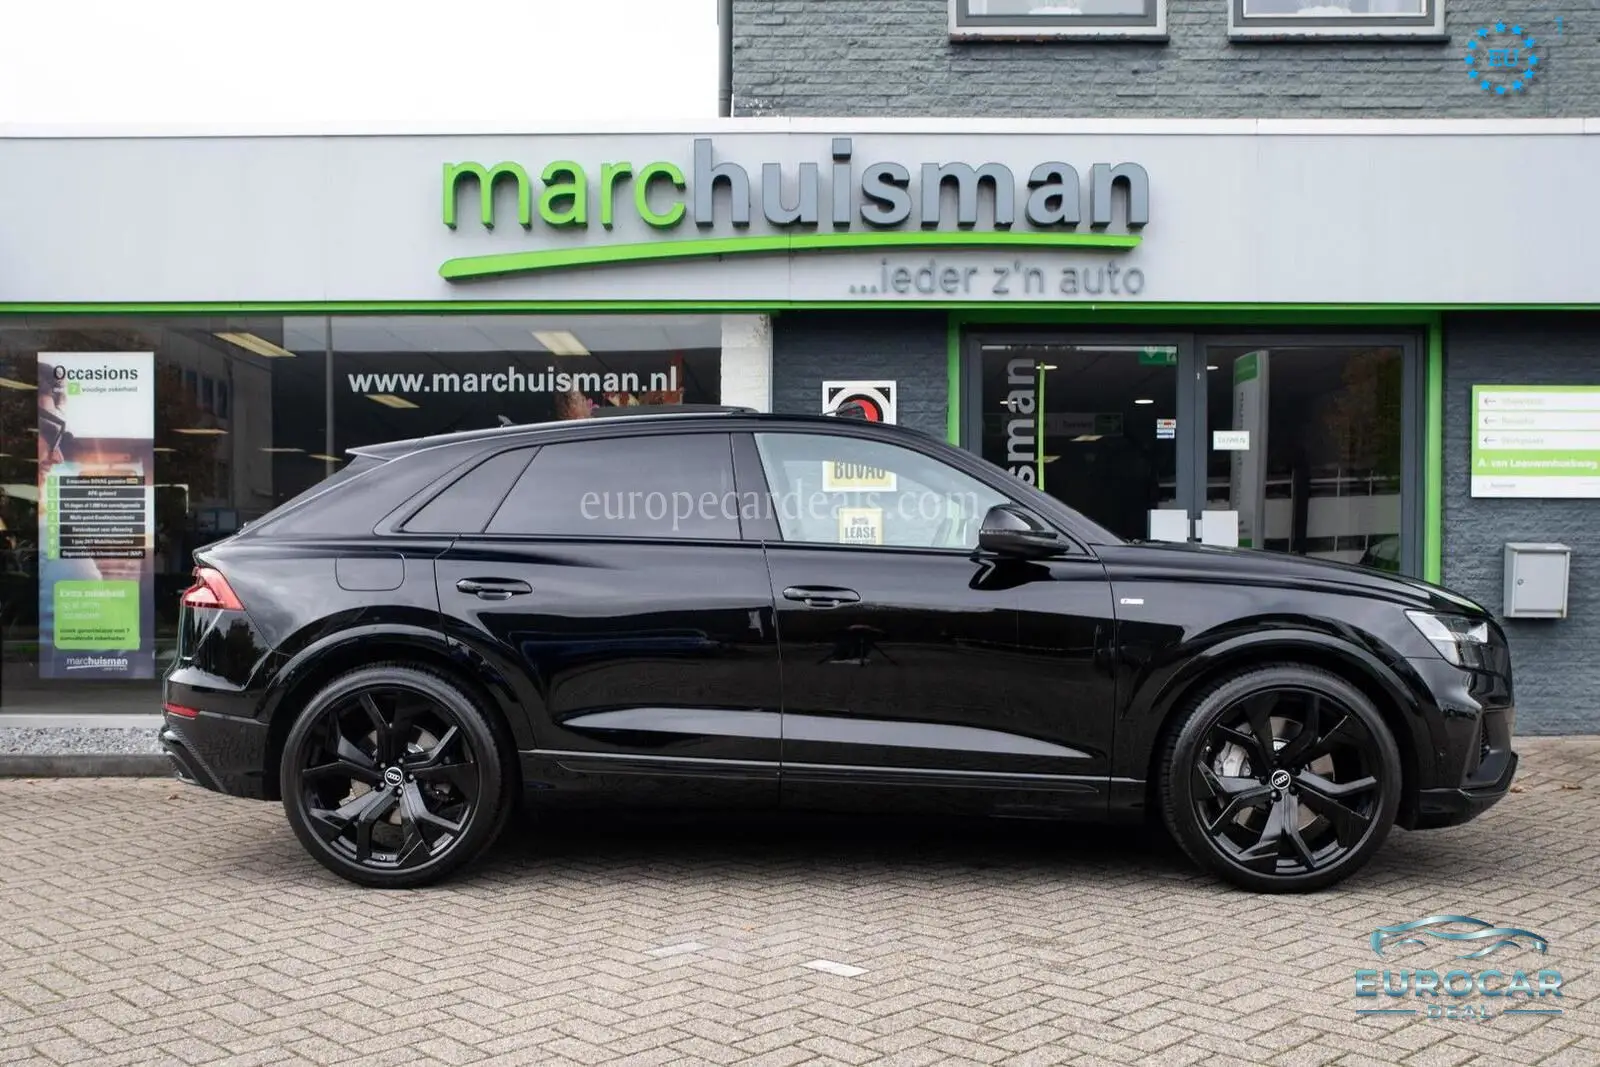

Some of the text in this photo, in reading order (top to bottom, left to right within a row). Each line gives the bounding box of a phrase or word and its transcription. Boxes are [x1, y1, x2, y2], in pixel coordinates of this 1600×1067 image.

[442, 138, 1150, 231] marchuisman
[992, 261, 1045, 295] z'n
[1060, 264, 1147, 295] auto
[53, 365, 138, 380] Occasions
[348, 366, 677, 393] www.marchuisman.nl
[844, 526, 877, 539] LEASE
[66, 656, 128, 665] marchuisman
